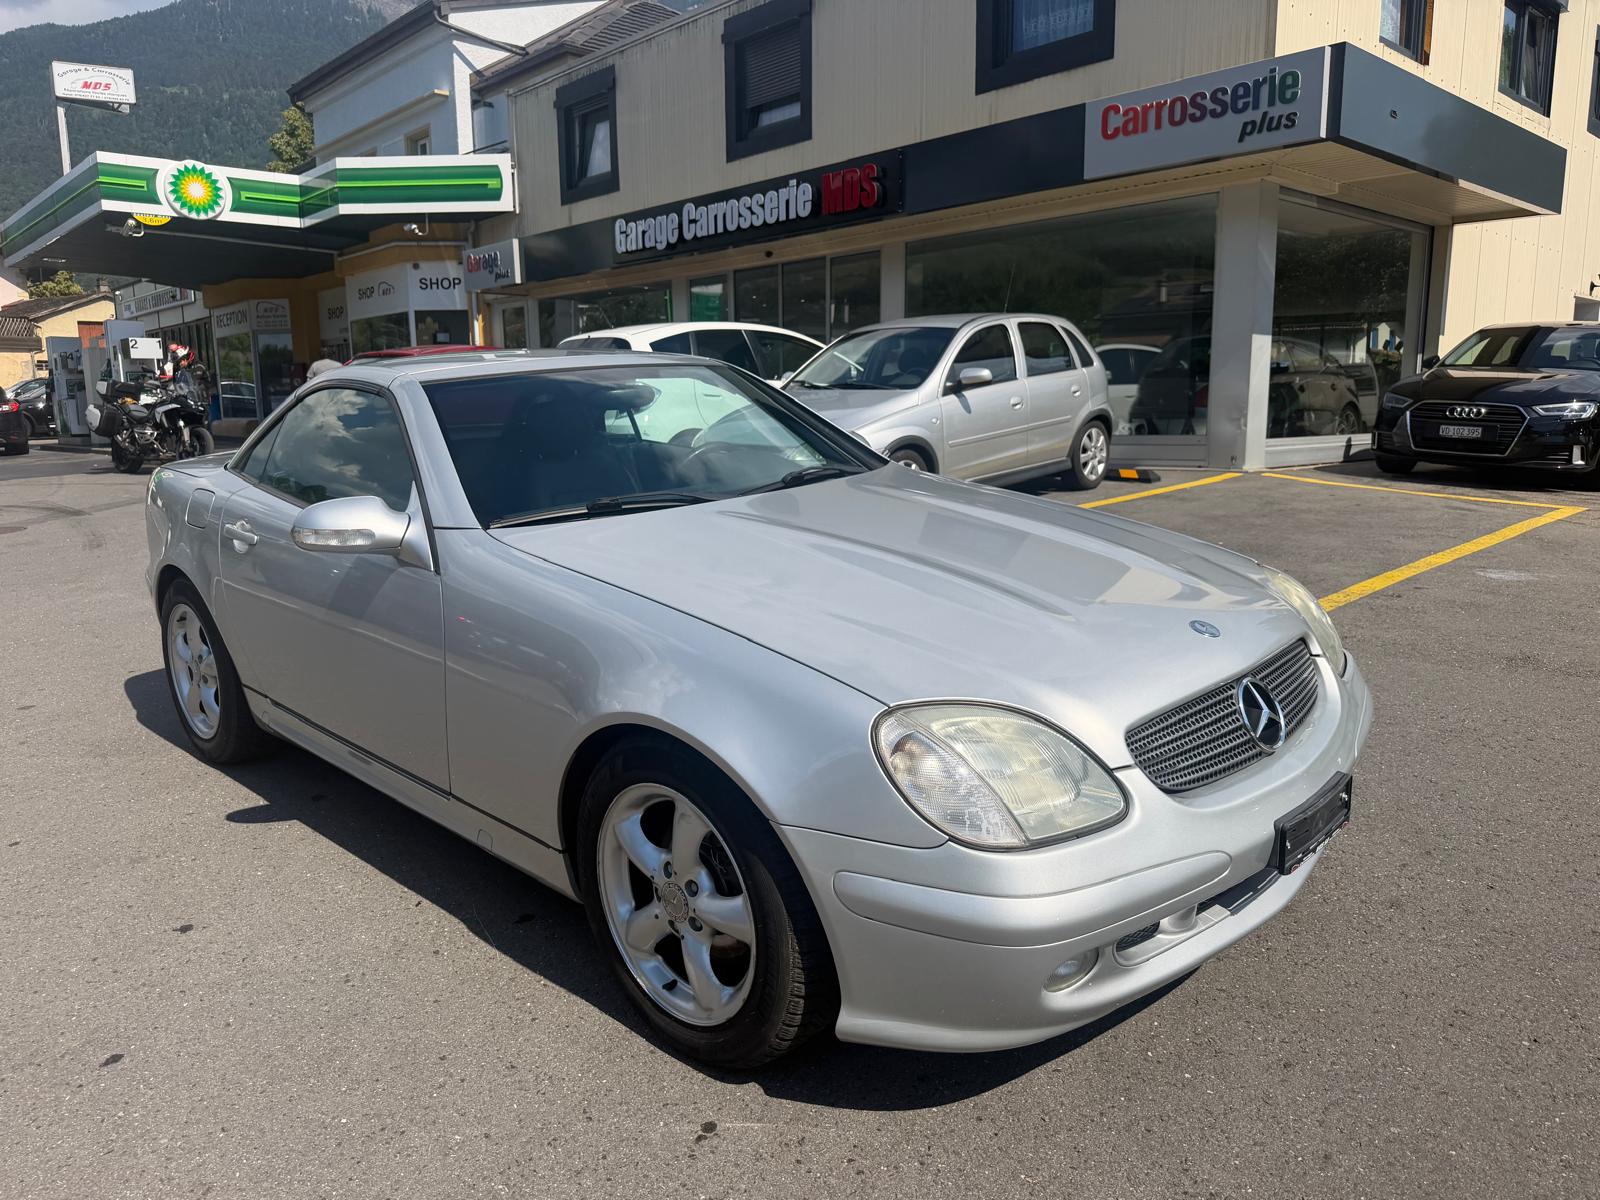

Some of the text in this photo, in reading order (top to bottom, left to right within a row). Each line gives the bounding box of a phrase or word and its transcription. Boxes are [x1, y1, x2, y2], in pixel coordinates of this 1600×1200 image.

[1101, 66, 1301, 141] Carrosserie
[1237, 110, 1299, 143] plus
[614, 163, 878, 254] Garage Carrosserie MDS
[467, 251, 501, 275] Garage
[494, 267, 511, 282] plus
[419, 277, 462, 290] SHOP
[358, 286, 375, 300] SHOP
[216, 308, 248, 328] RECEPTION
[328, 305, 344, 320] SHOP
[130, 339, 138, 349] 2
[156, 339, 162, 350] 1
[1441, 426, 1450, 434] VD
[1452, 427, 1465, 436] 102
